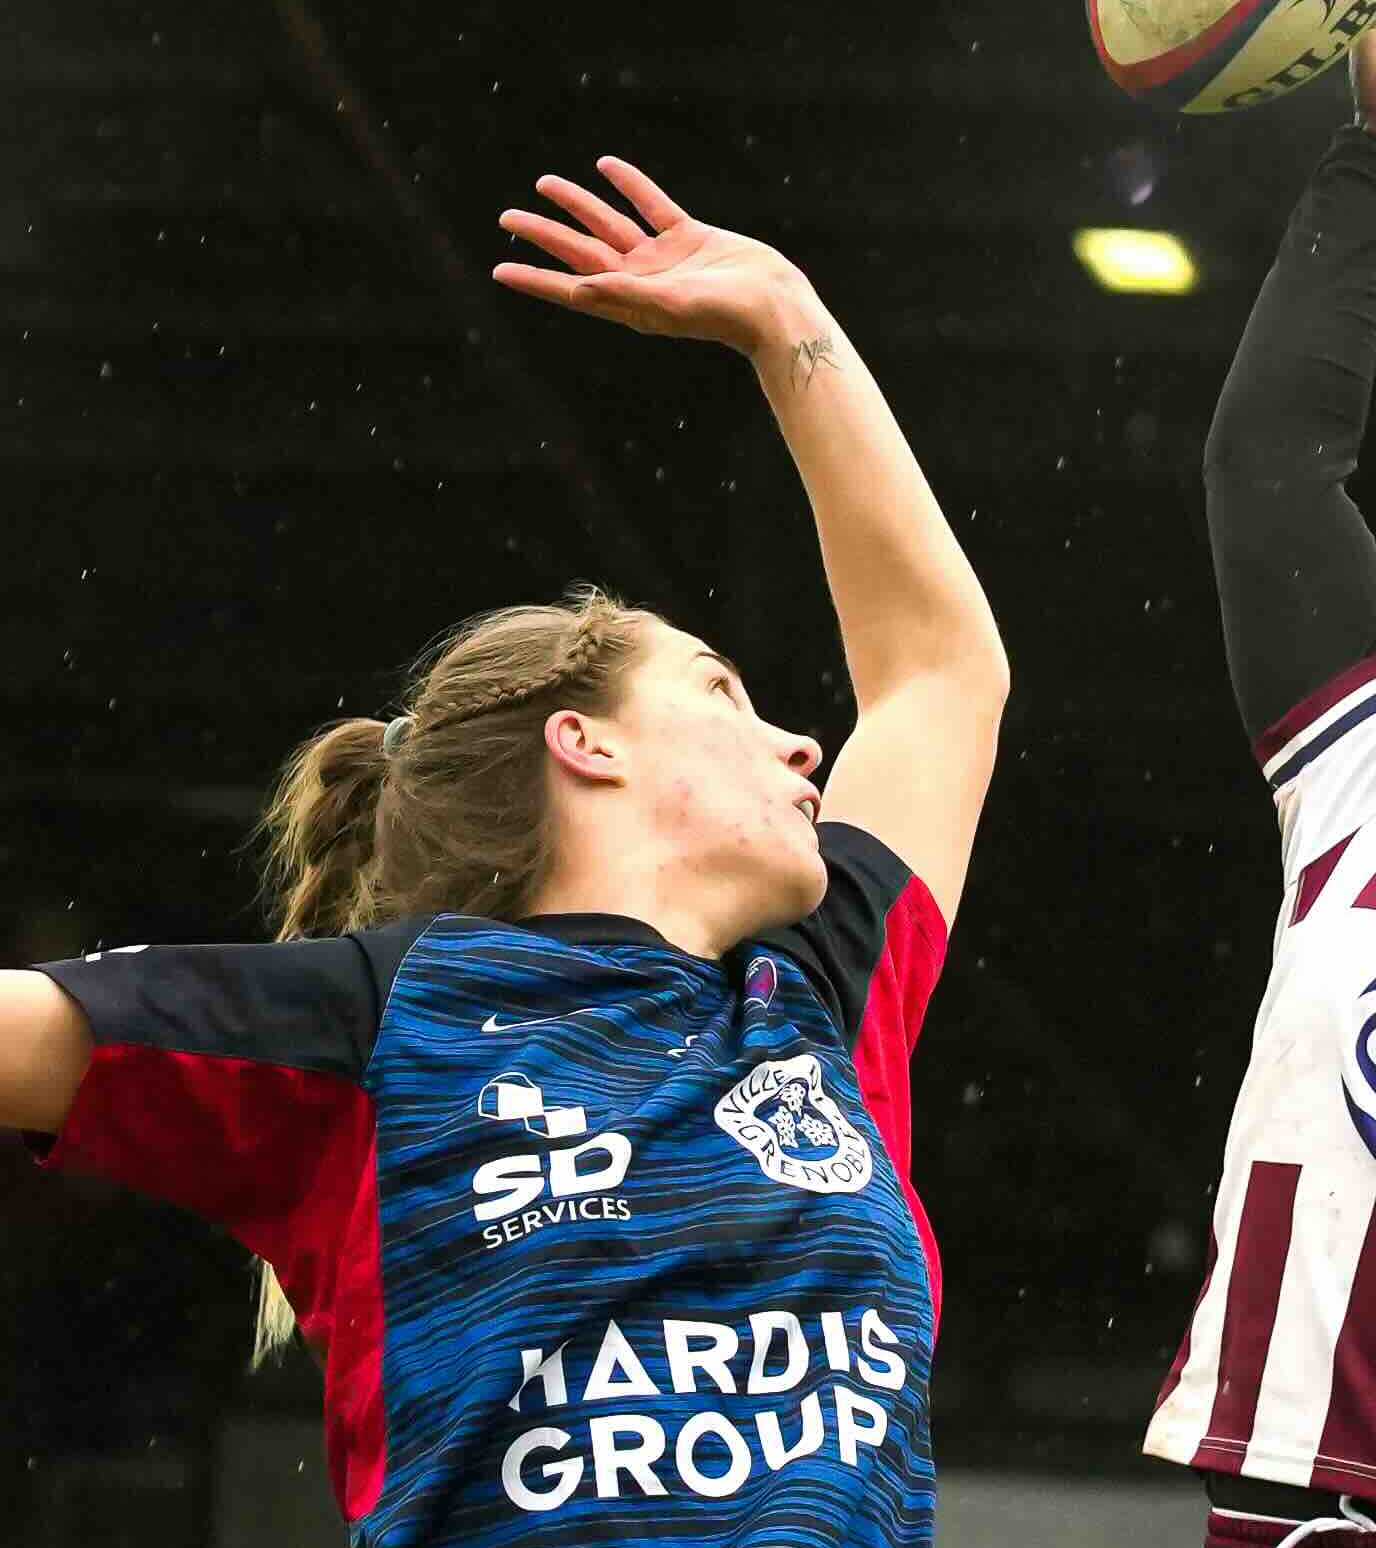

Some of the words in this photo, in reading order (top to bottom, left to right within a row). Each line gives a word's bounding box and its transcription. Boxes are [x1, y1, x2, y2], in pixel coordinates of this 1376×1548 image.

[722, 1068, 786, 1114] VILLE
[472, 1132, 632, 1222] SD
[482, 1197, 632, 1249] SERVICES
[508, 1308, 906, 1412] HARDIS
[501, 1384, 888, 1512] GROUP
